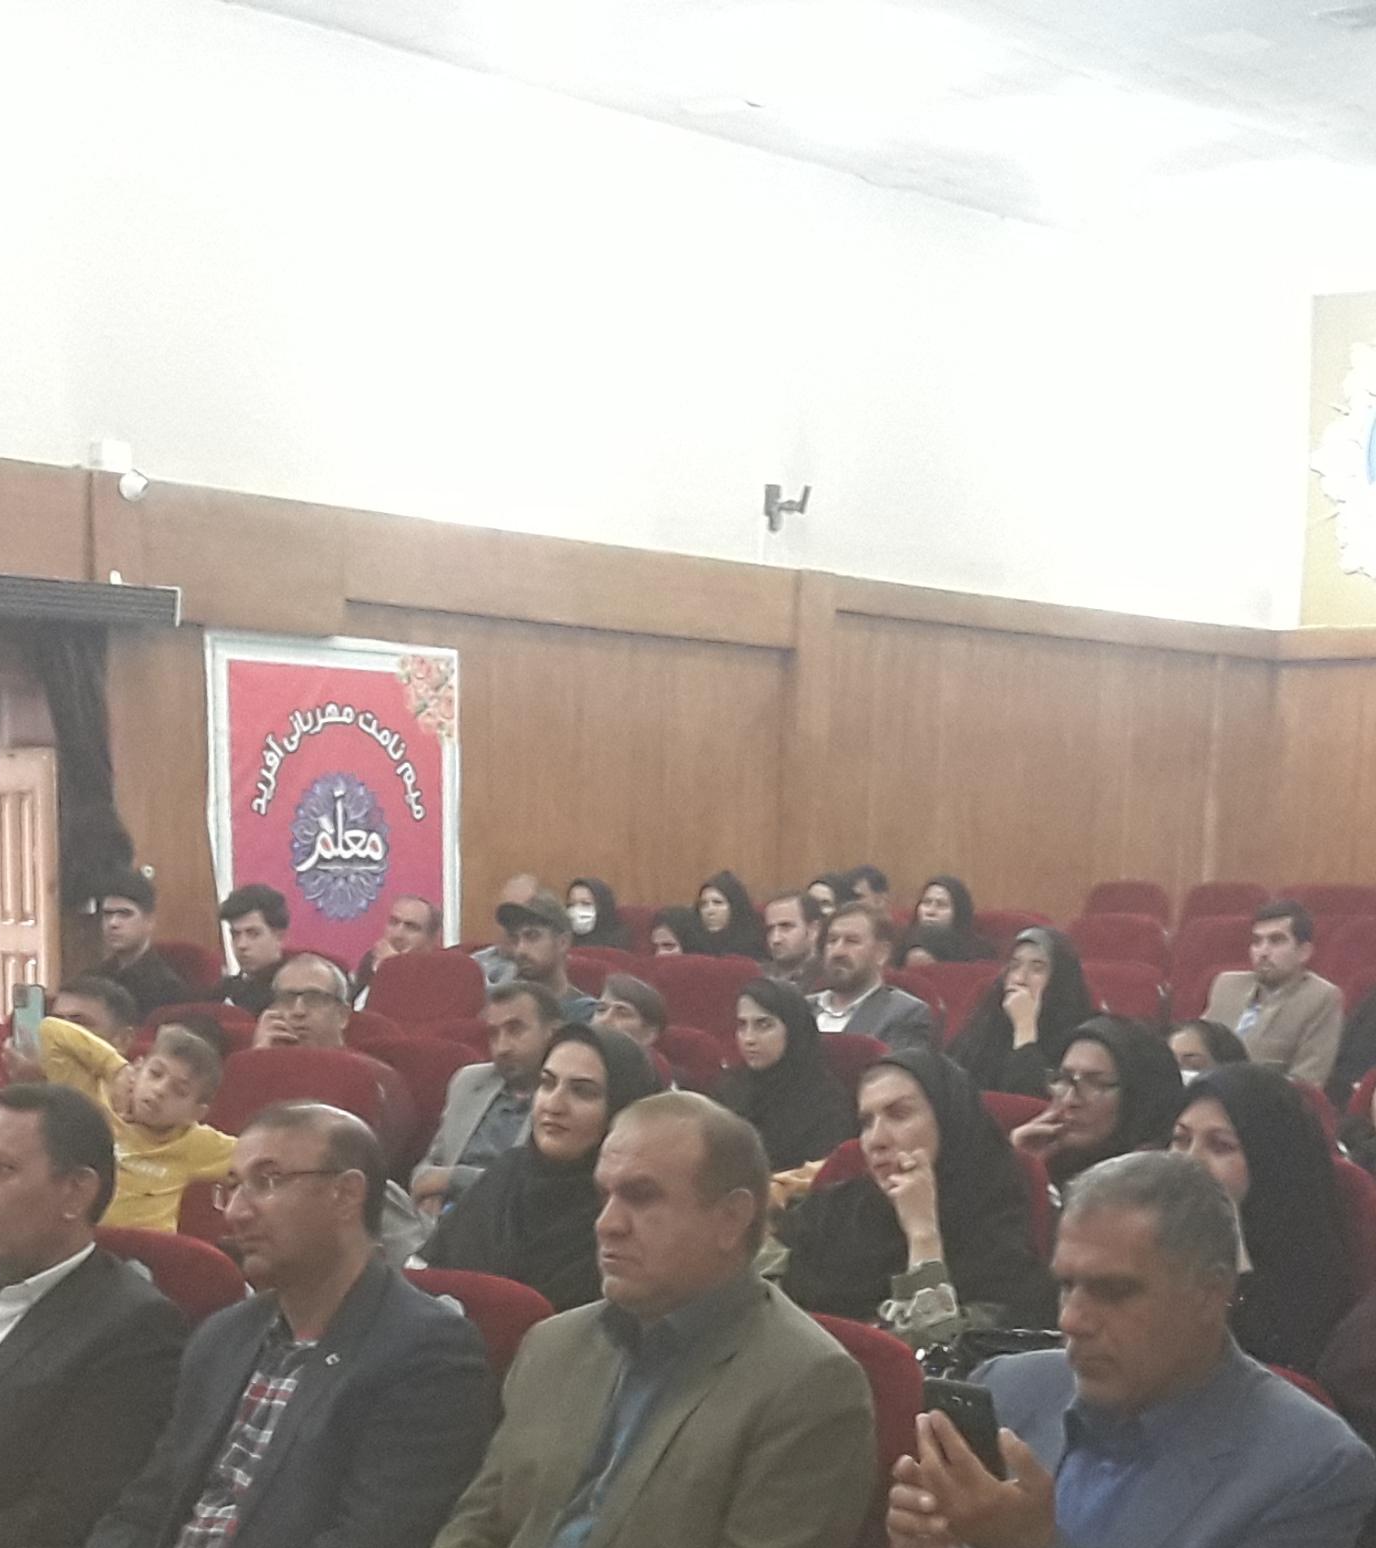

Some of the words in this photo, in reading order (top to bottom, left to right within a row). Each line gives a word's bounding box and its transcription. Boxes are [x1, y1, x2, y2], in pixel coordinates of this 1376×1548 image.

[281, 702, 354, 752] مهربانی
[358, 712, 408, 760] نامت
[396, 762, 426, 820] میم
